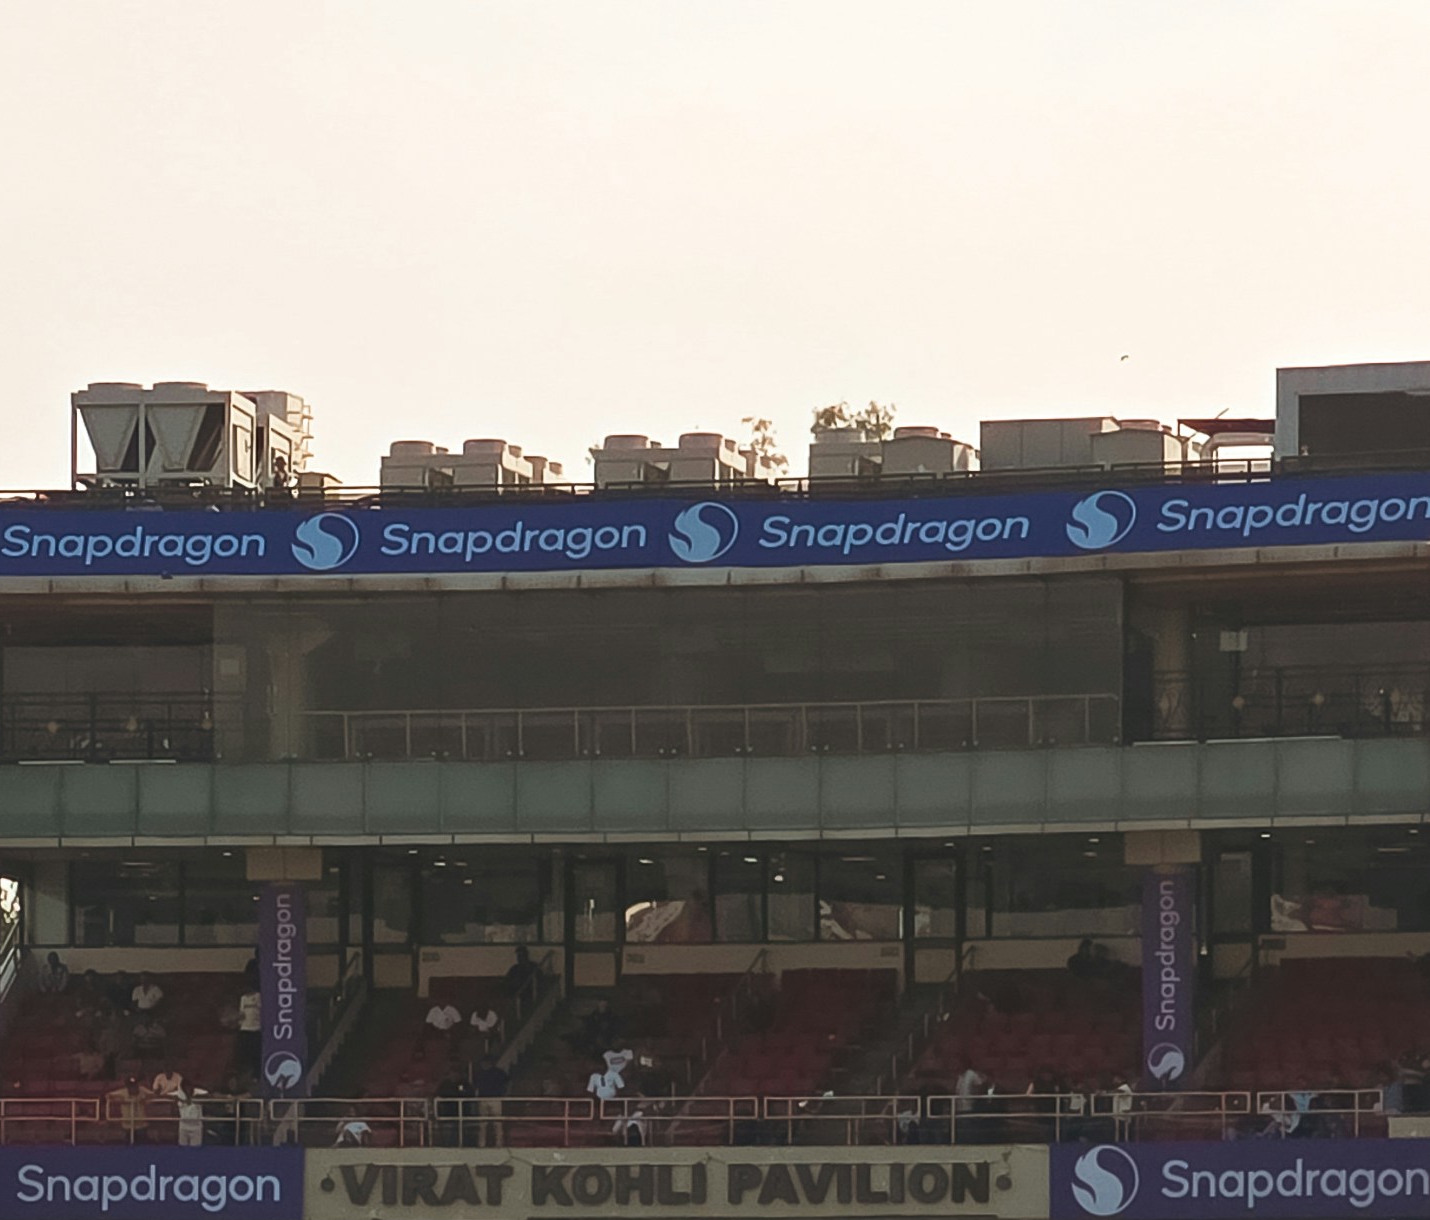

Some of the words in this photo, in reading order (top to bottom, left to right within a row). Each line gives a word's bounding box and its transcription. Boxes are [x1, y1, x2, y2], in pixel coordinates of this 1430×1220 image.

[759, 513, 1030, 555] Snapdragon
[1157, 493, 1430, 537] Snapdragon
[1, 525, 266, 566] Snapdragon
[381, 521, 647, 562] Snapdragon
[272, 894, 294, 1040] Snapdragon
[1154, 881, 1180, 1031] Snapdragon
[17, 1165, 282, 1212] Snapdragon
[341, 1165, 514, 1206] VIRAT
[532, 1164, 707, 1206] KOHLI
[728, 1162, 992, 1204] PAVILION
[1161, 1158, 1430, 1208] Snapdragon
